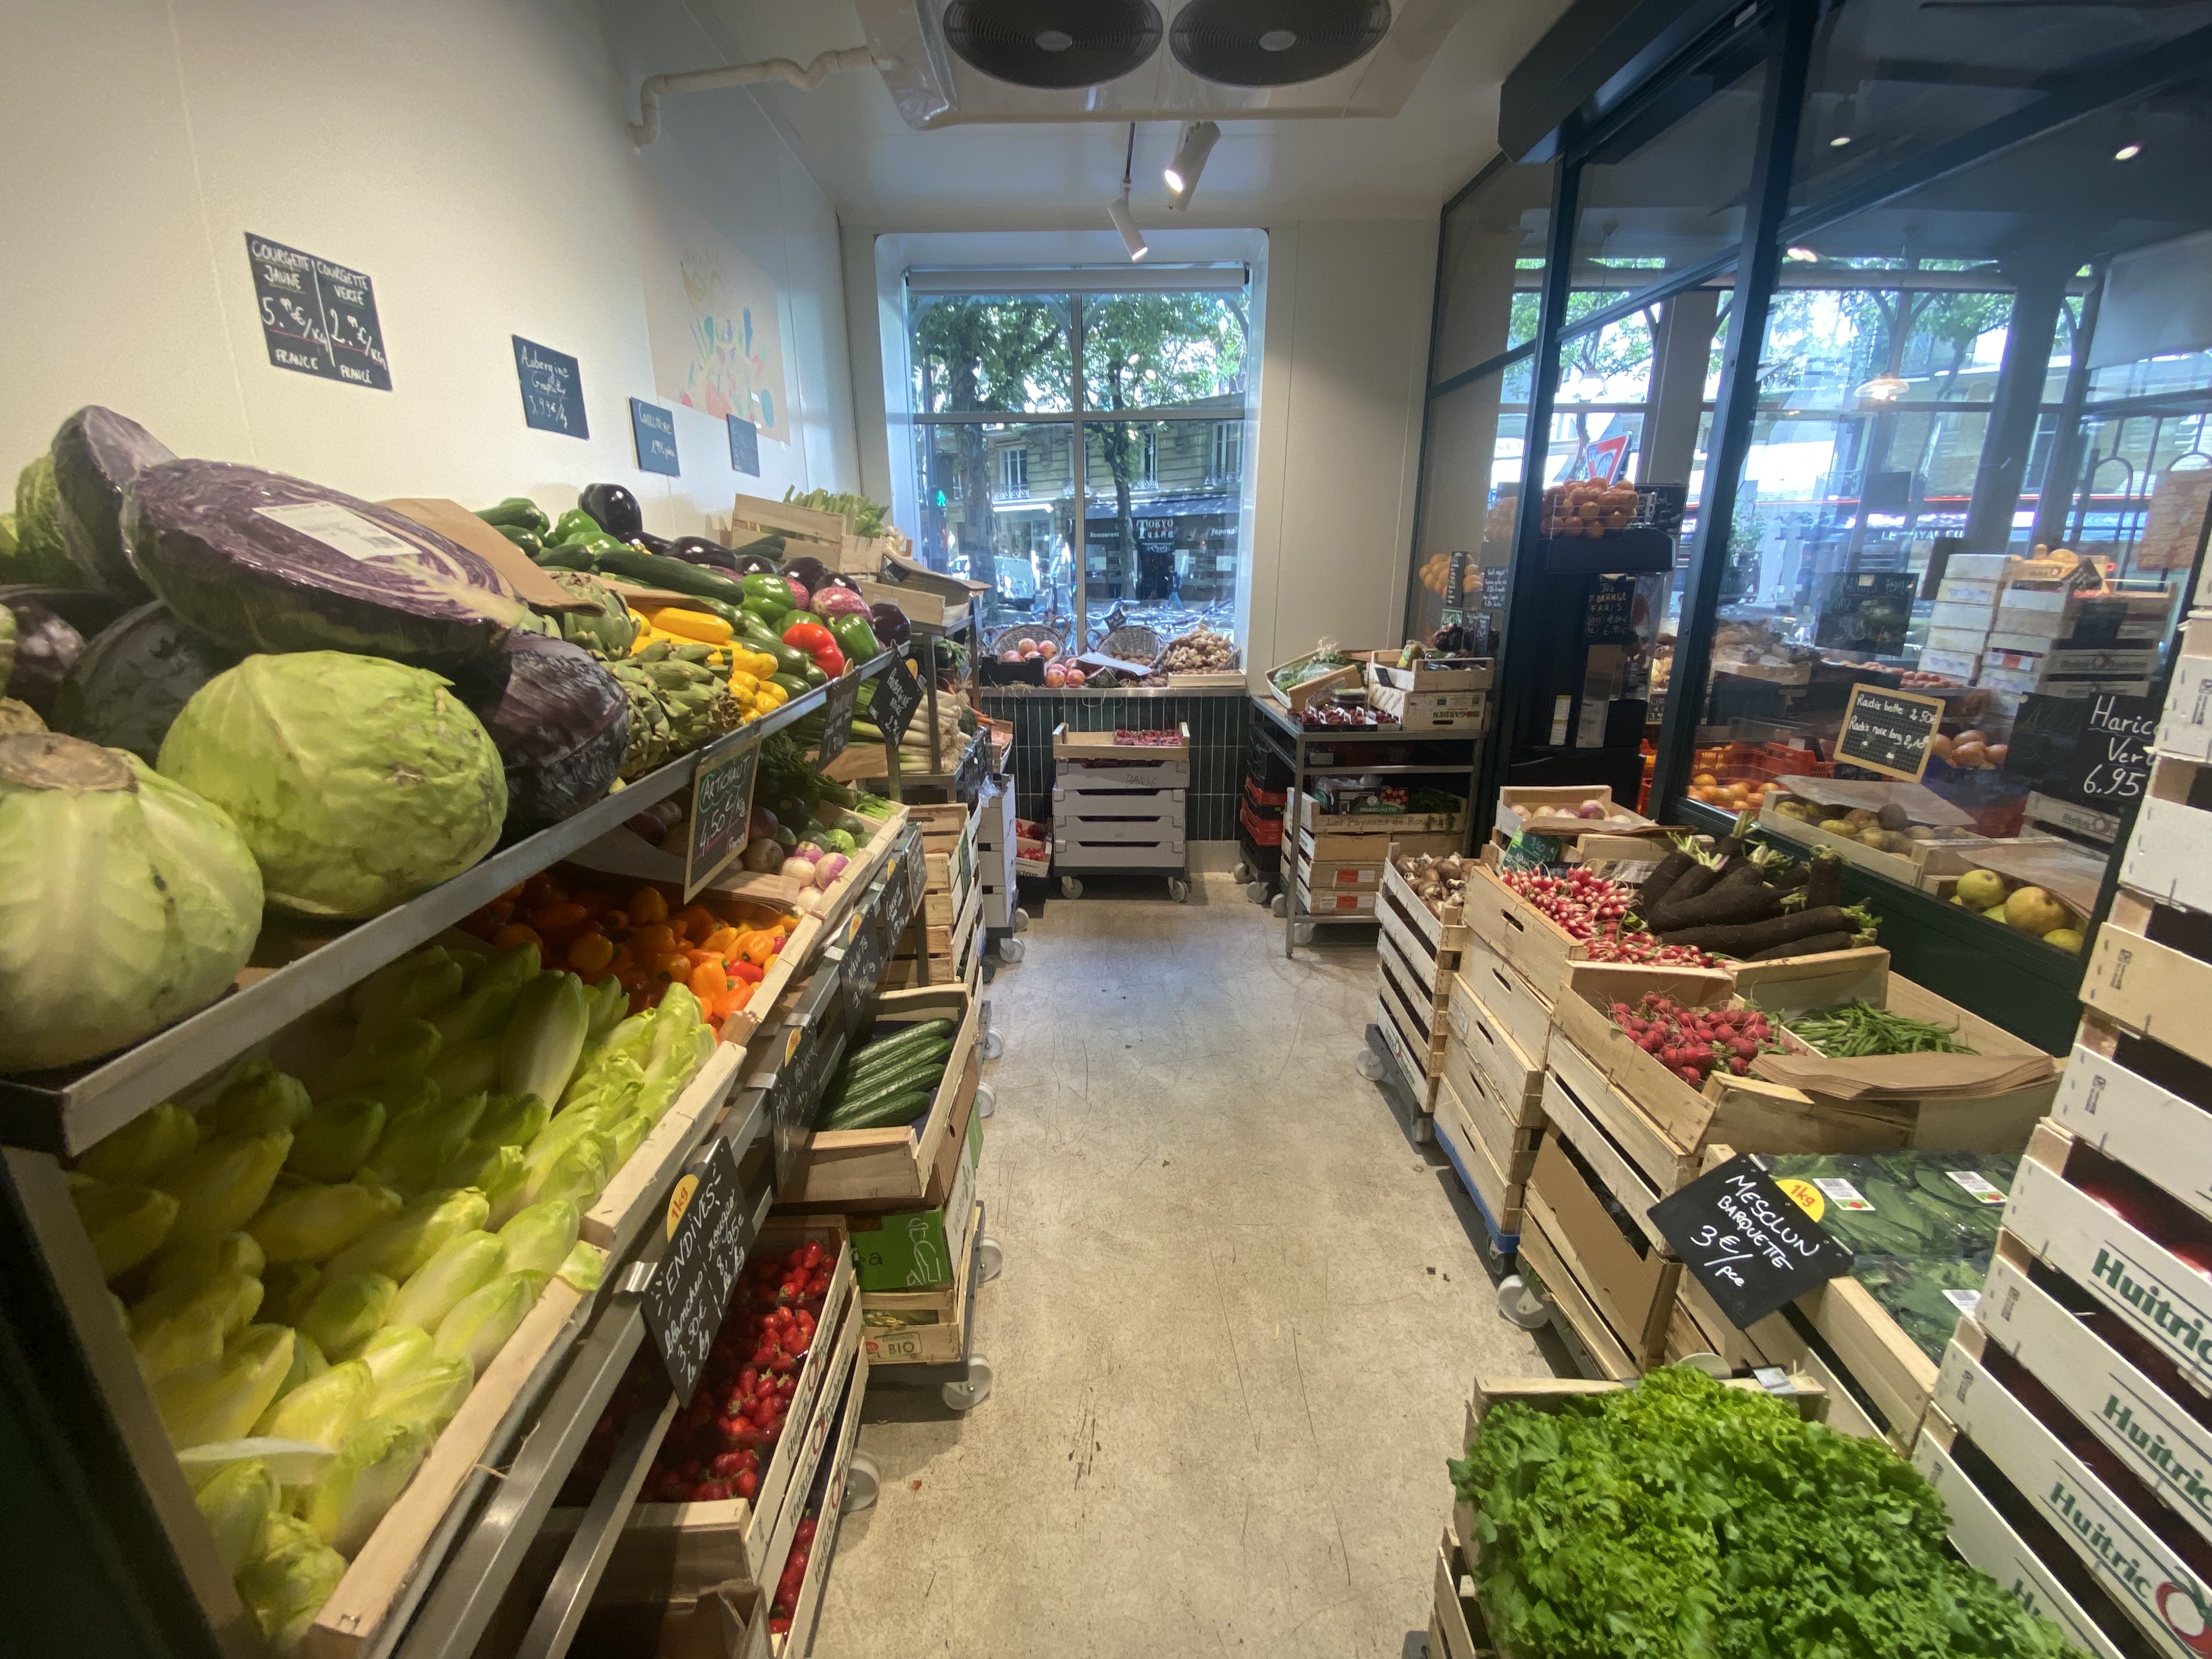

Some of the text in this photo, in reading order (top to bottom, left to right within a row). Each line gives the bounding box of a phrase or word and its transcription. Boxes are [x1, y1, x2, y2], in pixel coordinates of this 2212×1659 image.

[264, 264, 301, 290] JAUNE
[334, 285, 365, 306] VERTE
[1136, 518, 1174, 539] TOKYO
[1857, 693, 1882, 710] Radis
[1884, 699, 1904, 715] botte
[2090, 695, 2158, 735] Haric
[2084, 764, 2146, 797] 6.95
[671, 1186, 689, 1220] 1kg
[1790, 1184, 1816, 1208] 1kg
[1724, 1174, 1820, 1257] MESCLUN
[665, 1182, 715, 1296] ENDIVES
[1717, 1195, 1794, 1271] BARQUETTE
[2091, 1247, 2212, 1365] Huitric
[888, 1341, 915, 1355] BIO
[2102, 1393, 2212, 1512] Huitric
[2050, 1481, 2153, 1600] Huitric
